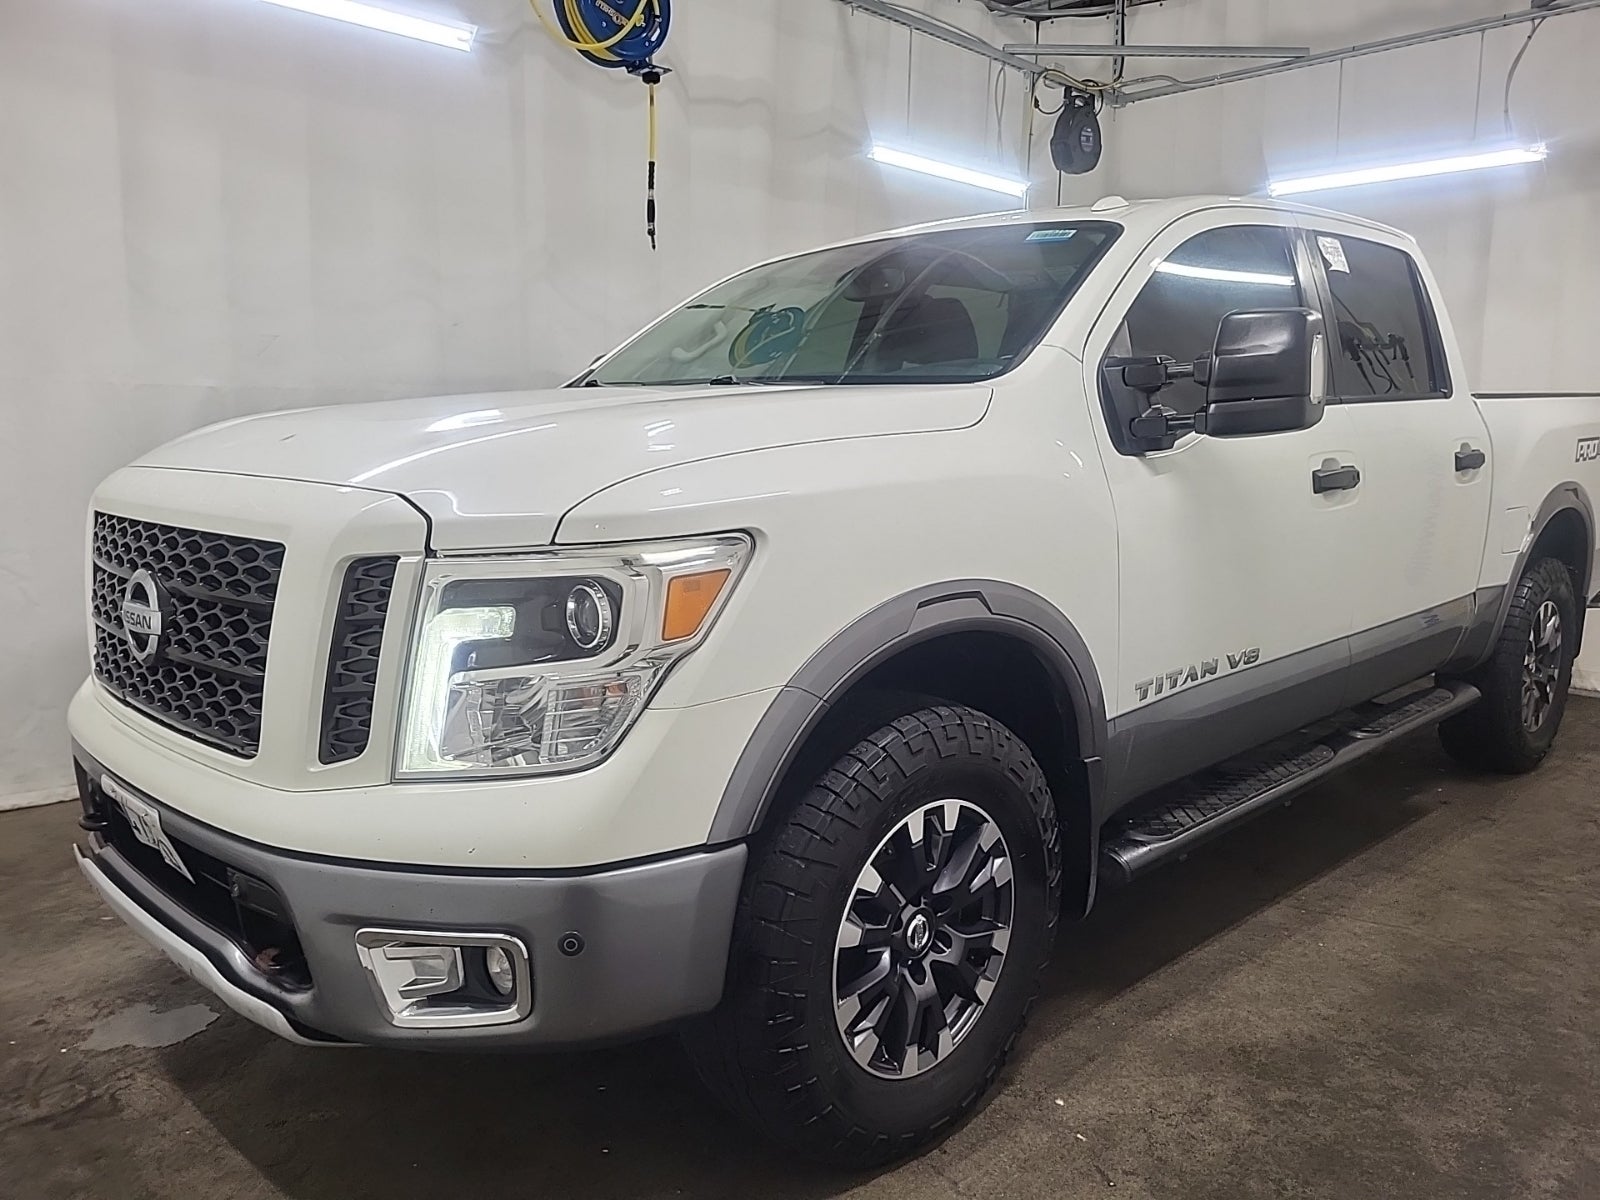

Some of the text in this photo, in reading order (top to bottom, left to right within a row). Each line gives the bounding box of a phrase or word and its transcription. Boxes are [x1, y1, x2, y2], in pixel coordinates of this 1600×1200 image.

[124, 608, 152, 630] SSAN
[1135, 647, 1260, 701] TITAN V8
